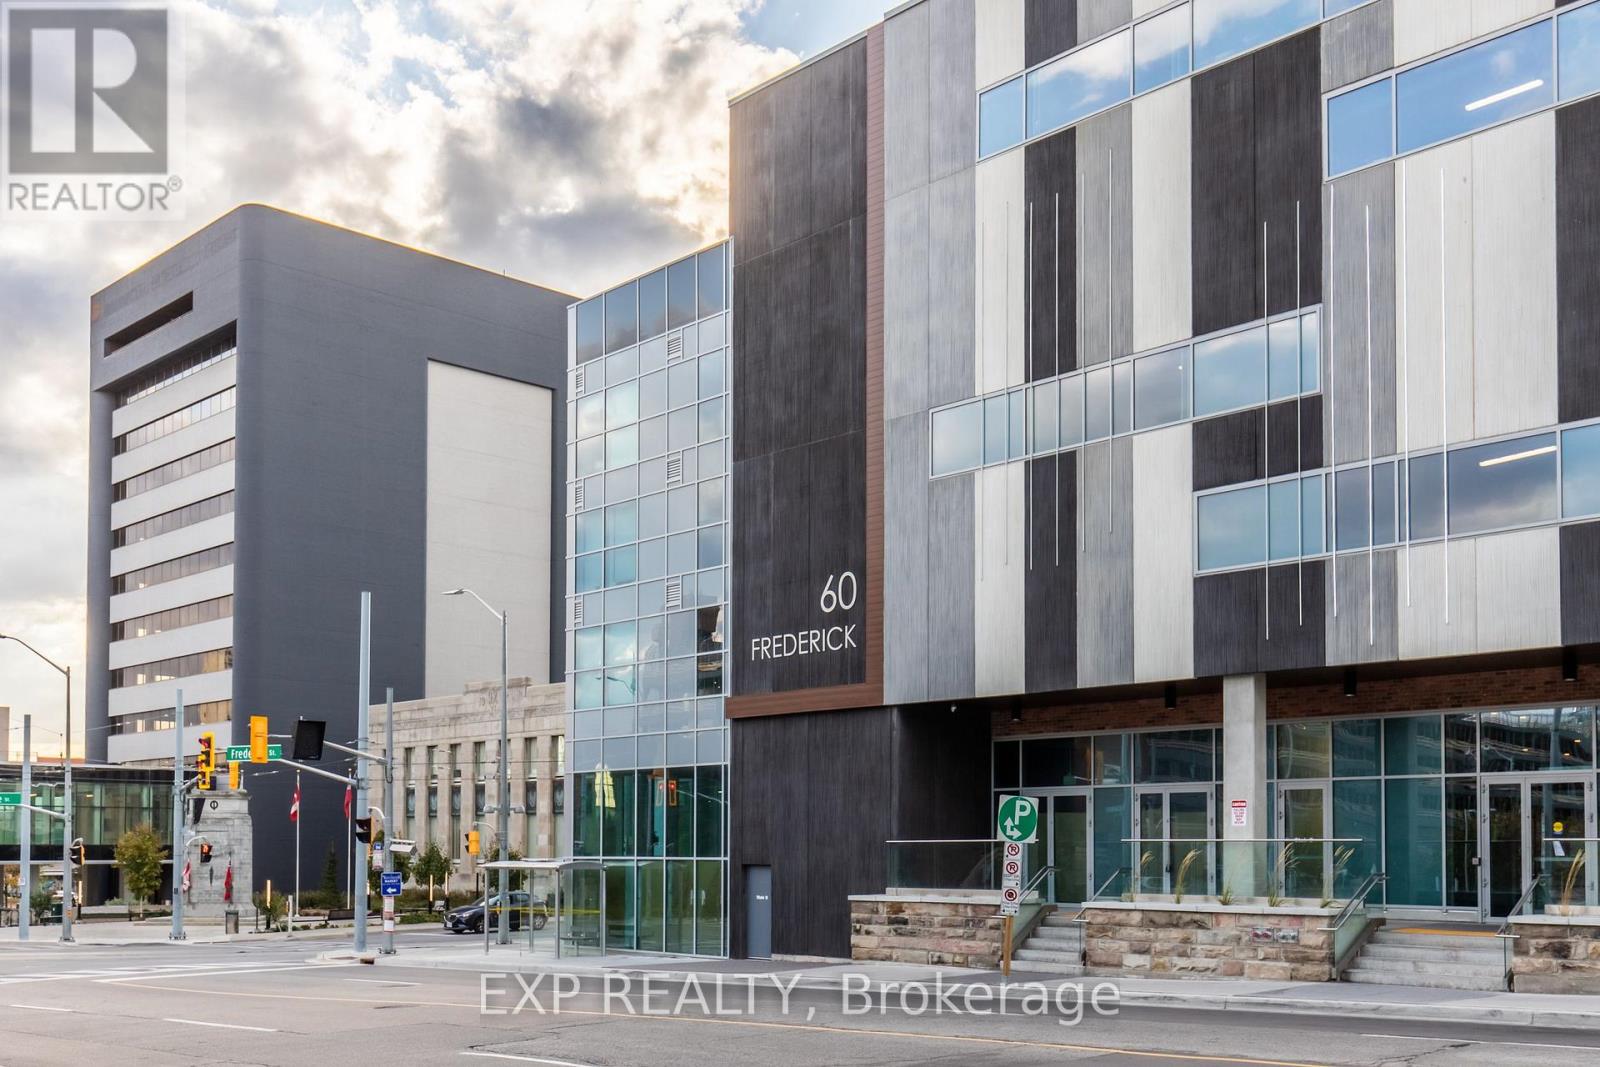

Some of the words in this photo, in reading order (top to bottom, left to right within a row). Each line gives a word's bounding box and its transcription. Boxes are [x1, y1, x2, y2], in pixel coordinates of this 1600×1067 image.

[820, 571, 857, 613] 60
[751, 624, 857, 661] FREDERICK
[1014, 800, 1031, 825] P
